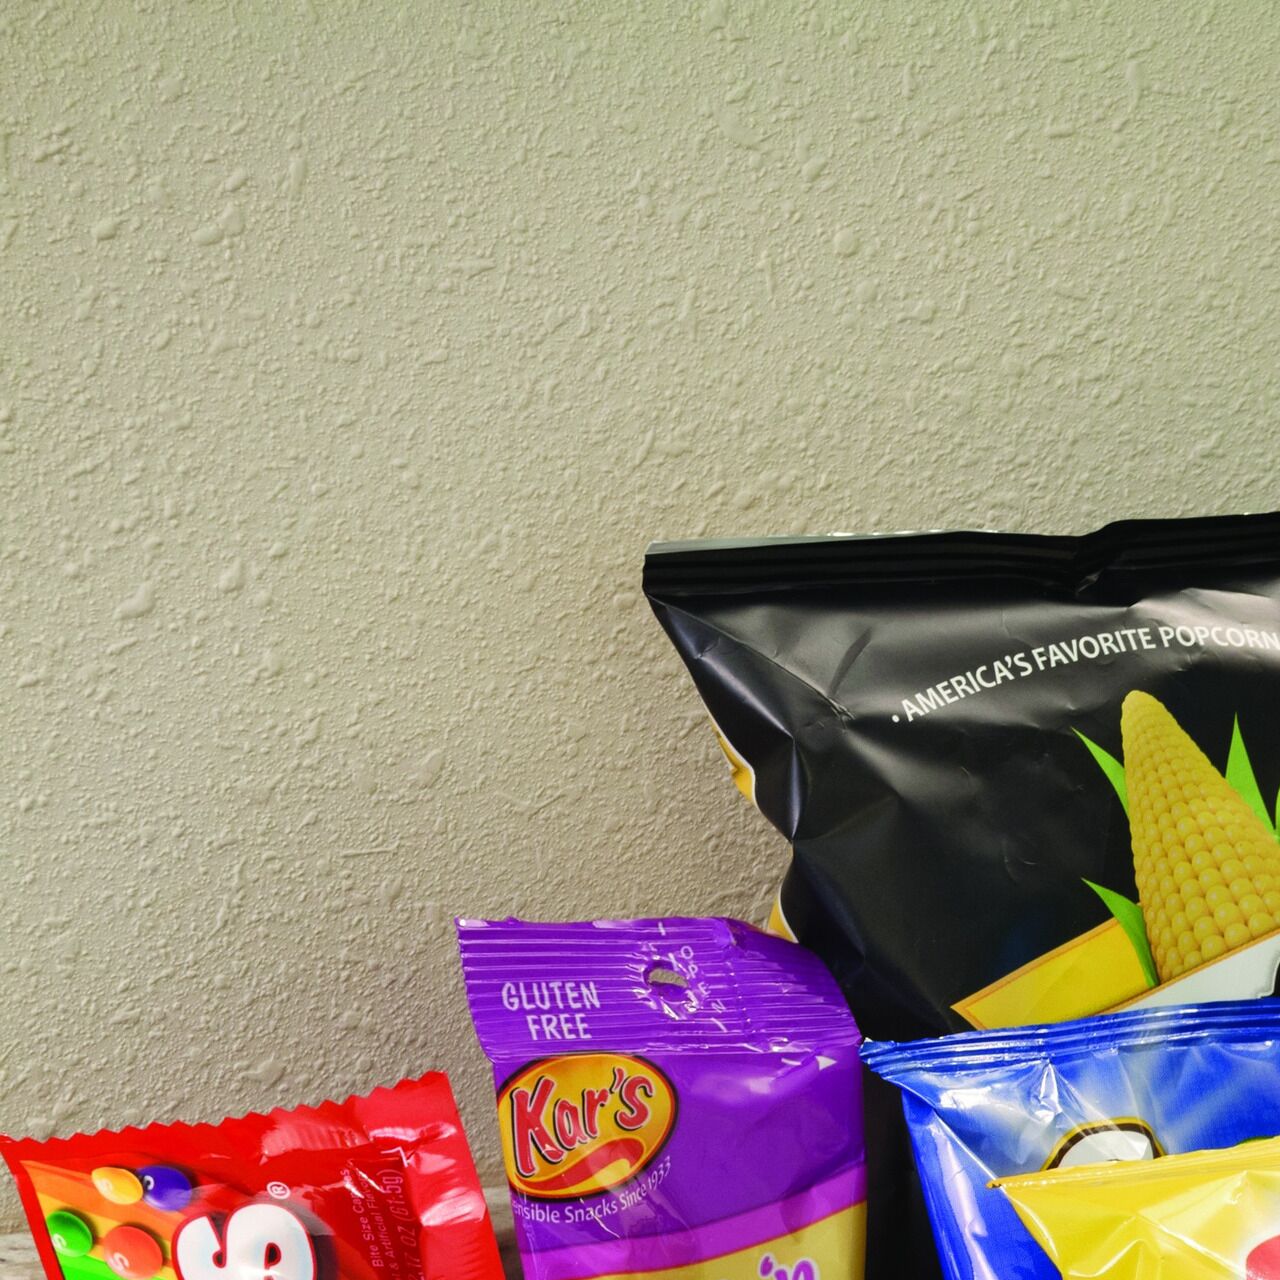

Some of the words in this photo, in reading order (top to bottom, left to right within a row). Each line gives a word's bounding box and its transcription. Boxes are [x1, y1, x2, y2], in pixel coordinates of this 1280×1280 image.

[901, 653, 1033, 722] AMERICA'S
[1031, 627, 1157, 671] FAVORITE
[501, 981, 600, 1011] GLUTEN
[526, 1013, 592, 1041] FREE
[511, 1066, 655, 1179] Kar's
[564, 1201, 617, 1224] Snacks
[620, 1184, 648, 1211] Since
[647, 1154, 671, 1192] 1933
[359, 1216, 376, 1242] Size
[370, 1244, 385, 1268] Bite
